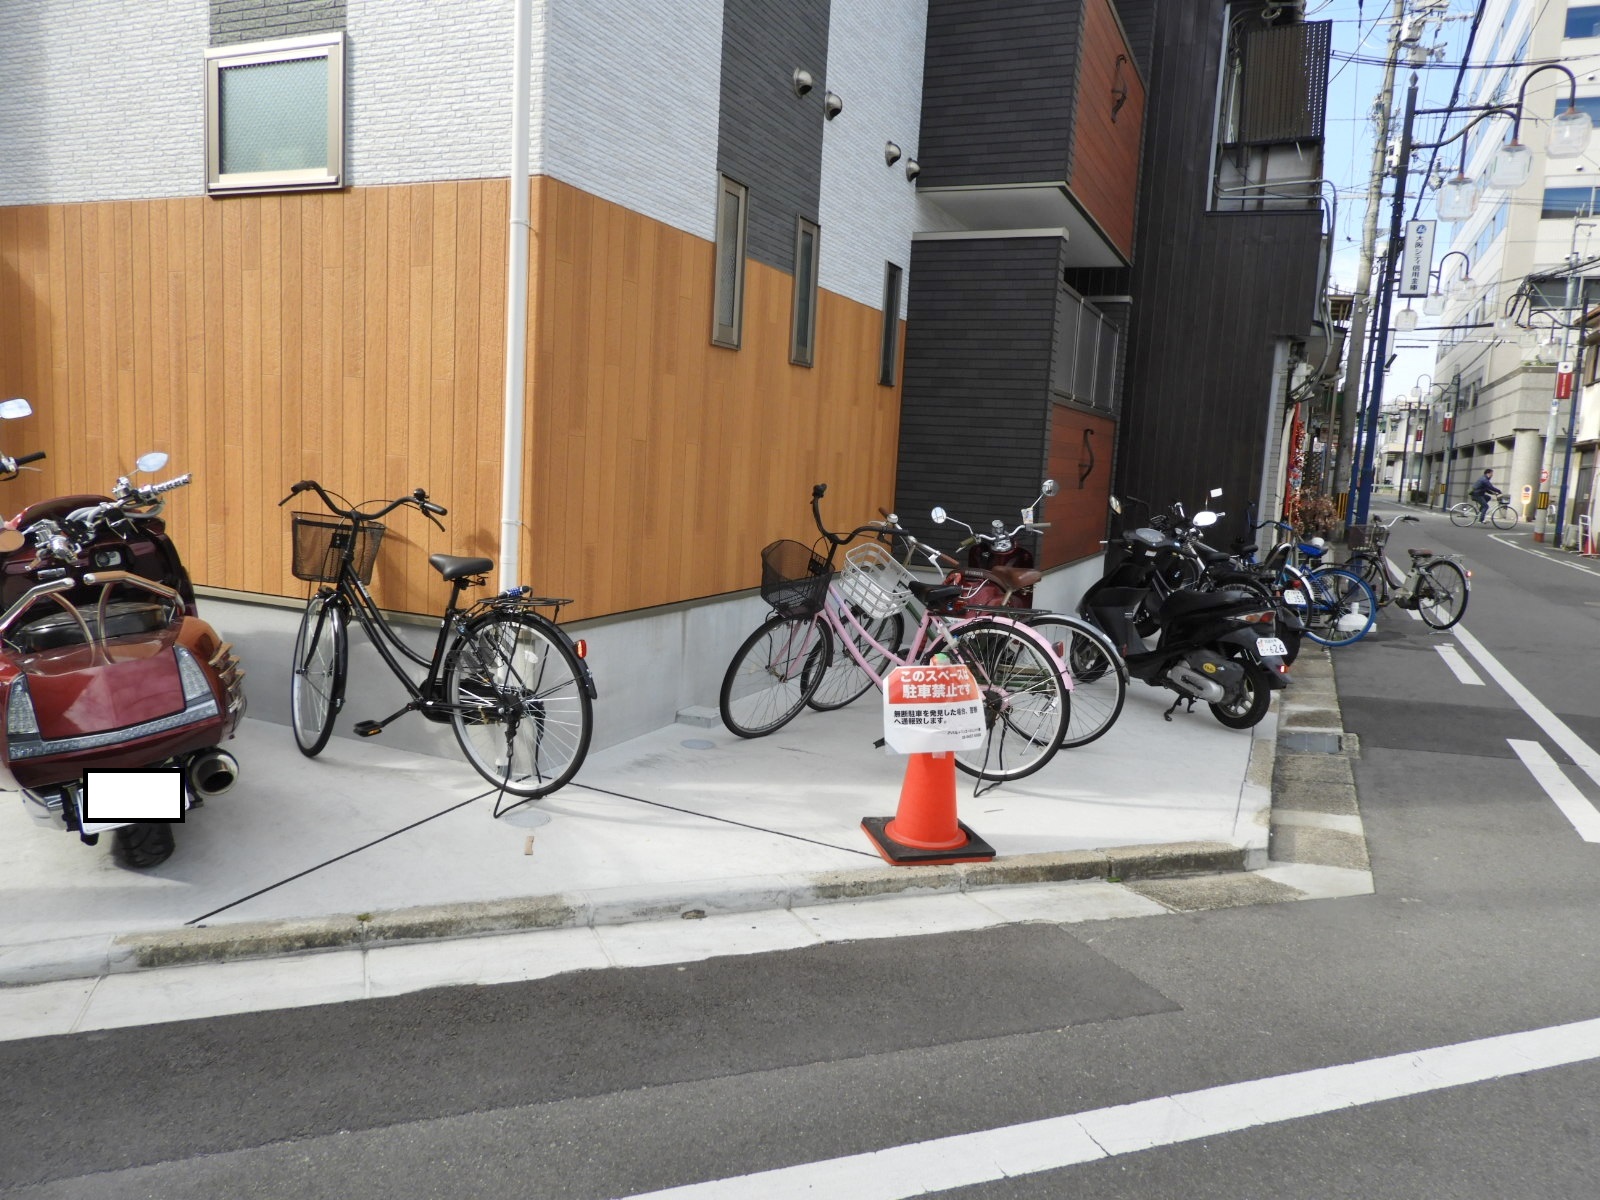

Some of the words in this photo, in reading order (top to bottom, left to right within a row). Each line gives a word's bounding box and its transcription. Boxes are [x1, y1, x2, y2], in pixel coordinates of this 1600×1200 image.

[900, 668, 970, 683] このスペースは
[902, 683, 971, 699] 駐車禁止です
